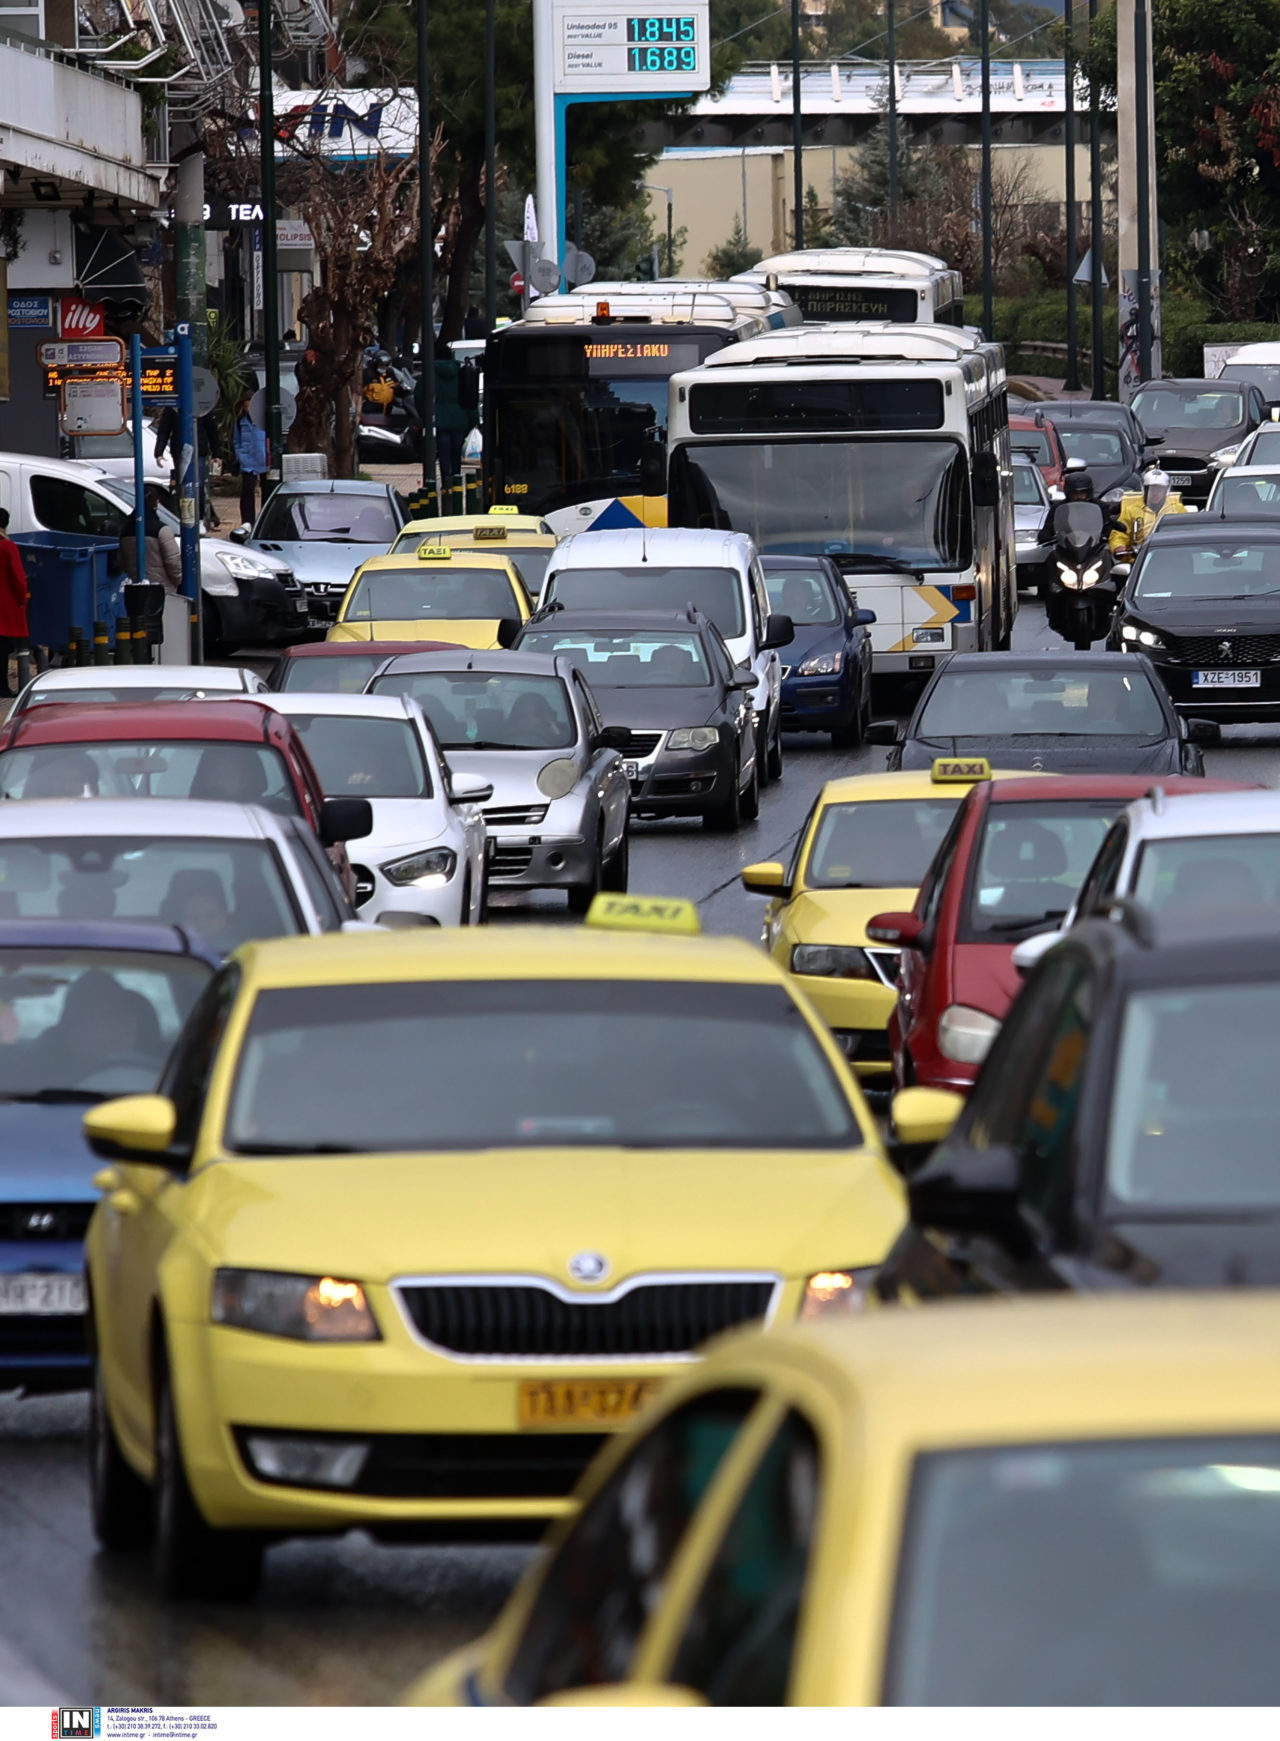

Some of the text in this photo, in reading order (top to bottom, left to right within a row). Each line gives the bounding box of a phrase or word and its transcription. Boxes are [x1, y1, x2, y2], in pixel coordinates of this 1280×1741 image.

[566, 18, 694, 42] Unleaded 95 1.845
[567, 47, 695, 72] Diesel 1.689
[808, 302, 888, 313] ΠΑΡΑΣΚΕΥΗ
[64, 304, 100, 335] illy
[939, 763, 984, 775] TAXI
[604, 901, 684, 920] TAXI
